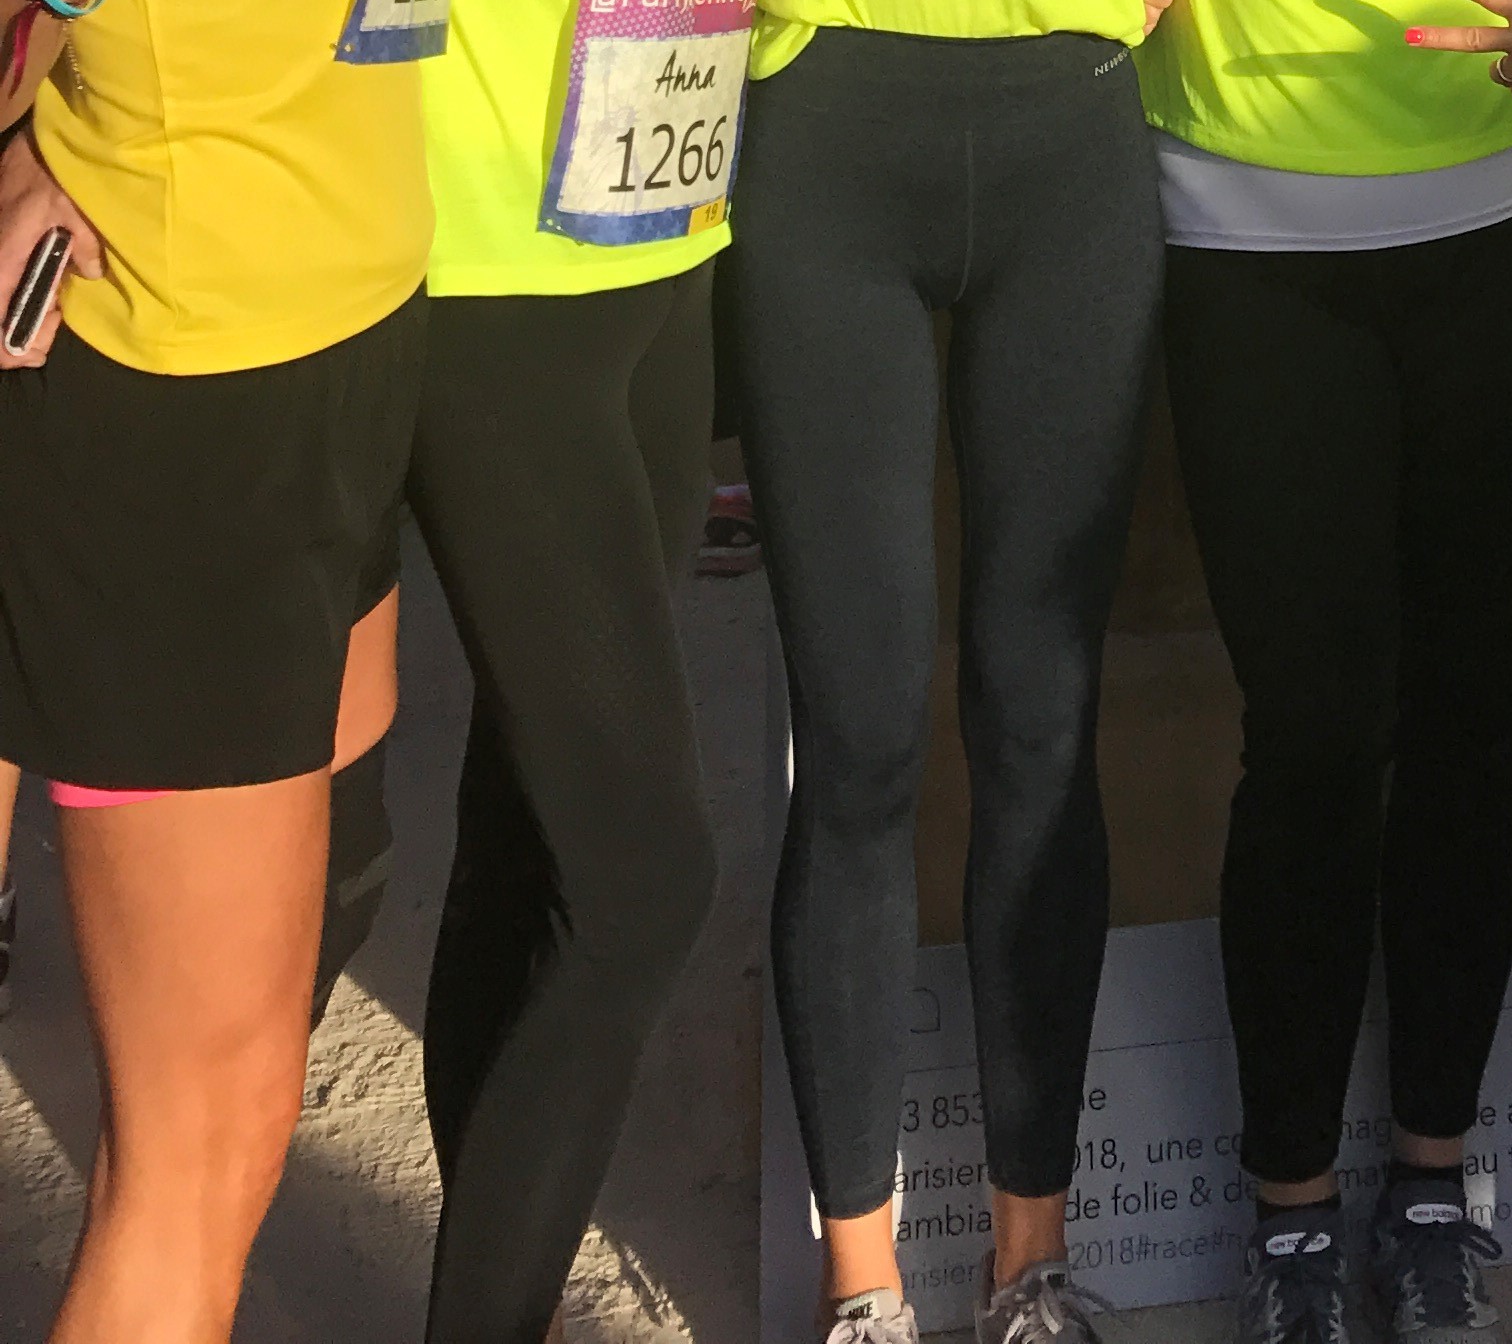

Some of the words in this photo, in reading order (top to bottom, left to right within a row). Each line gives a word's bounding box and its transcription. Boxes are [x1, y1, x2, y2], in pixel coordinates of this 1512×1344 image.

[653, 48, 717, 98] Anna
[607, 115, 728, 194] 1266
[703, 203, 720, 223] 19
[1147, 1137, 1203, 1164] une
[1111, 1181, 1179, 1216] folie
[1190, 1176, 1213, 1207] &
[1465, 1152, 1498, 1176] au
